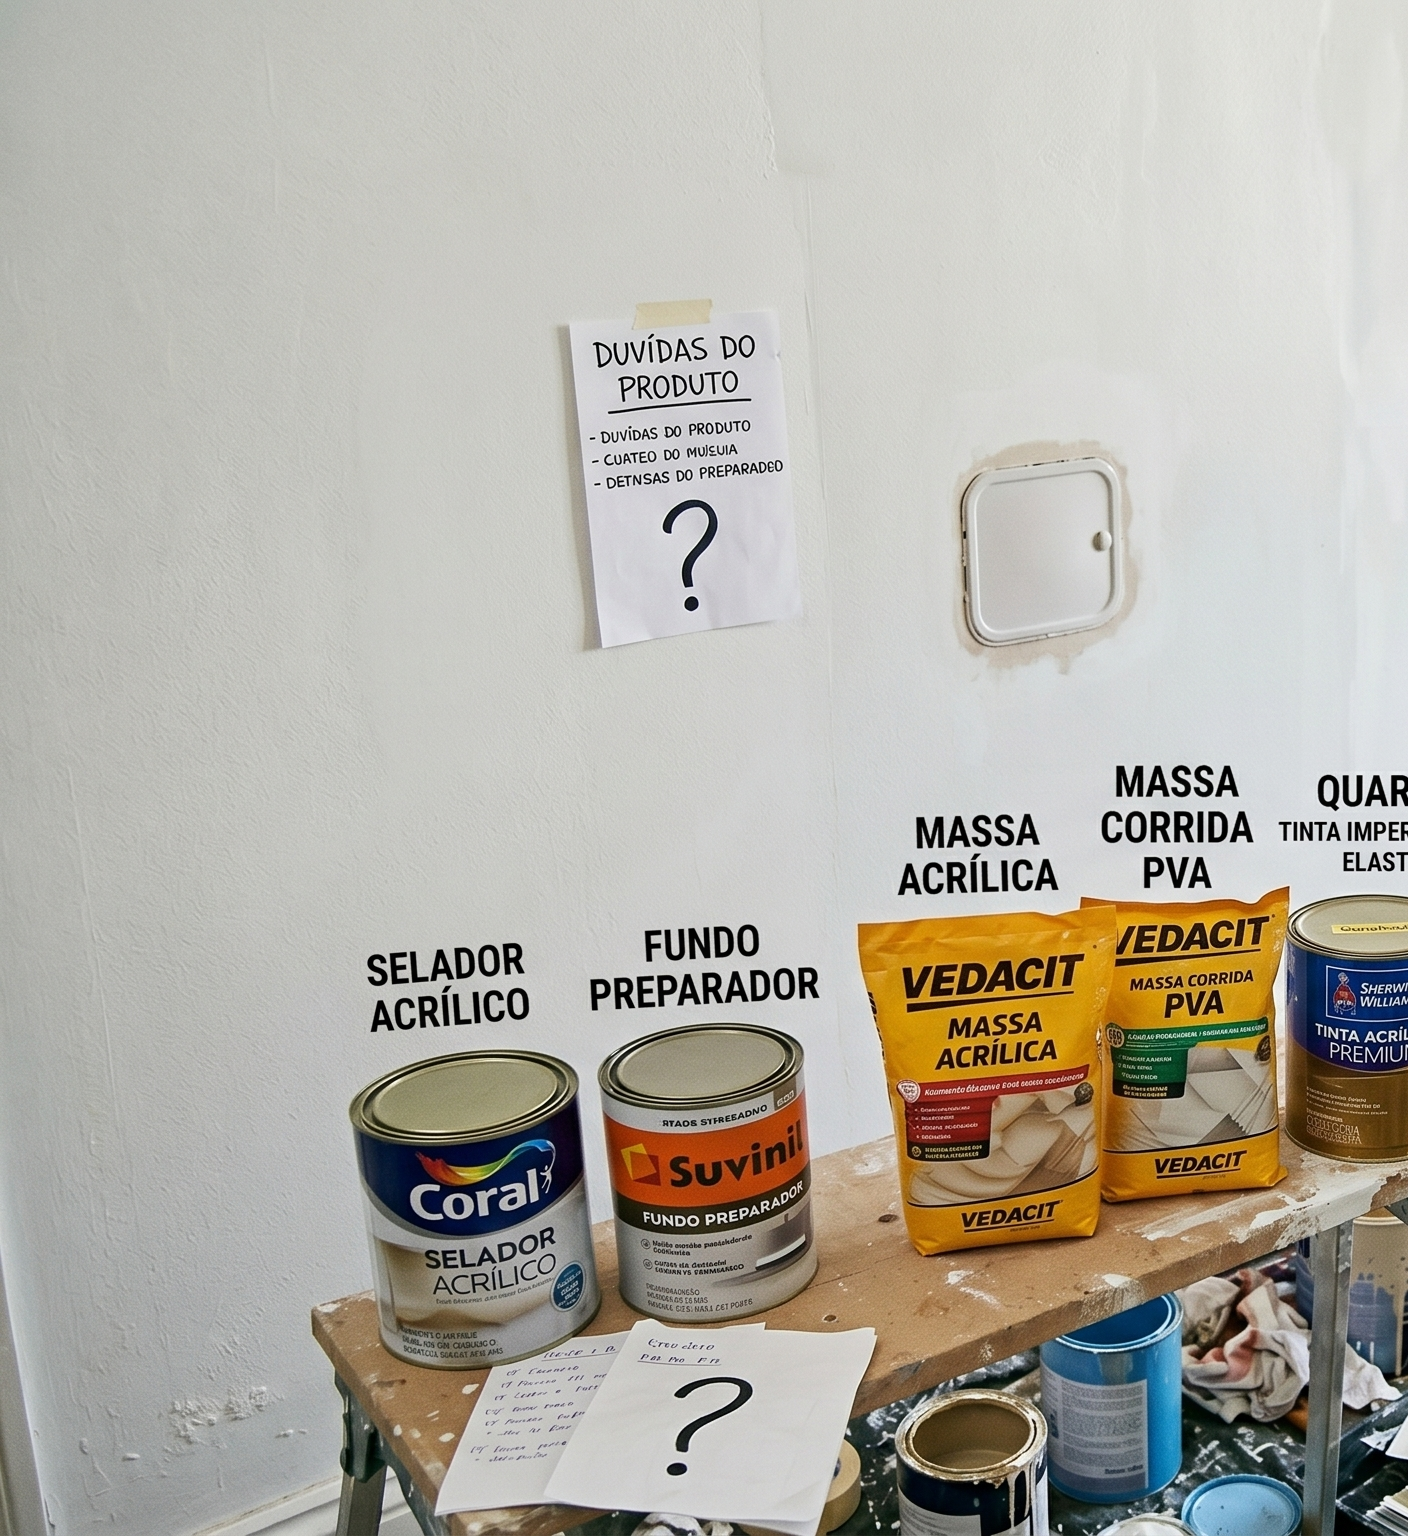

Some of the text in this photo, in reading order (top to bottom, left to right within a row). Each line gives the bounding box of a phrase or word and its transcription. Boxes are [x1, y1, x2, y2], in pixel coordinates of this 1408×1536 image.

[593, 333, 756, 369] DUVÍDAS DO
[618, 370, 739, 403] PRODUTO
[664, 425, 682, 438] DO
[688, 419, 751, 436] PRODUTO
[603, 450, 657, 466] CUATEO
[663, 448, 680, 461] DO
[606, 471, 670, 490] DETNSAS
[676, 469, 693, 482] DO
[663, 499, 718, 612] ?
[902, 953, 1086, 999] VEDACIT
[1130, 970, 1254, 991] MASSA CORRIDA
[1164, 990, 1224, 1019] PVA
[948, 1011, 1043, 1040] MASSA
[1315, 1023, 1360, 1043] TINTA
[935, 1038, 1058, 1070] ACRÍLICA
[669, 1119, 804, 1188] Suvinil
[1154, 1150, 1247, 1174] VEDACIT
[409, 1168, 539, 1221] Coral
[643, 1180, 804, 1227] FUNDO PREPARADOR
[961, 1200, 1061, 1228] VEDACIT
[424, 1226, 556, 1270] SELADOR
[432, 1253, 557, 1296] ACRÍLICO
[666, 1375, 754, 1477] ?
